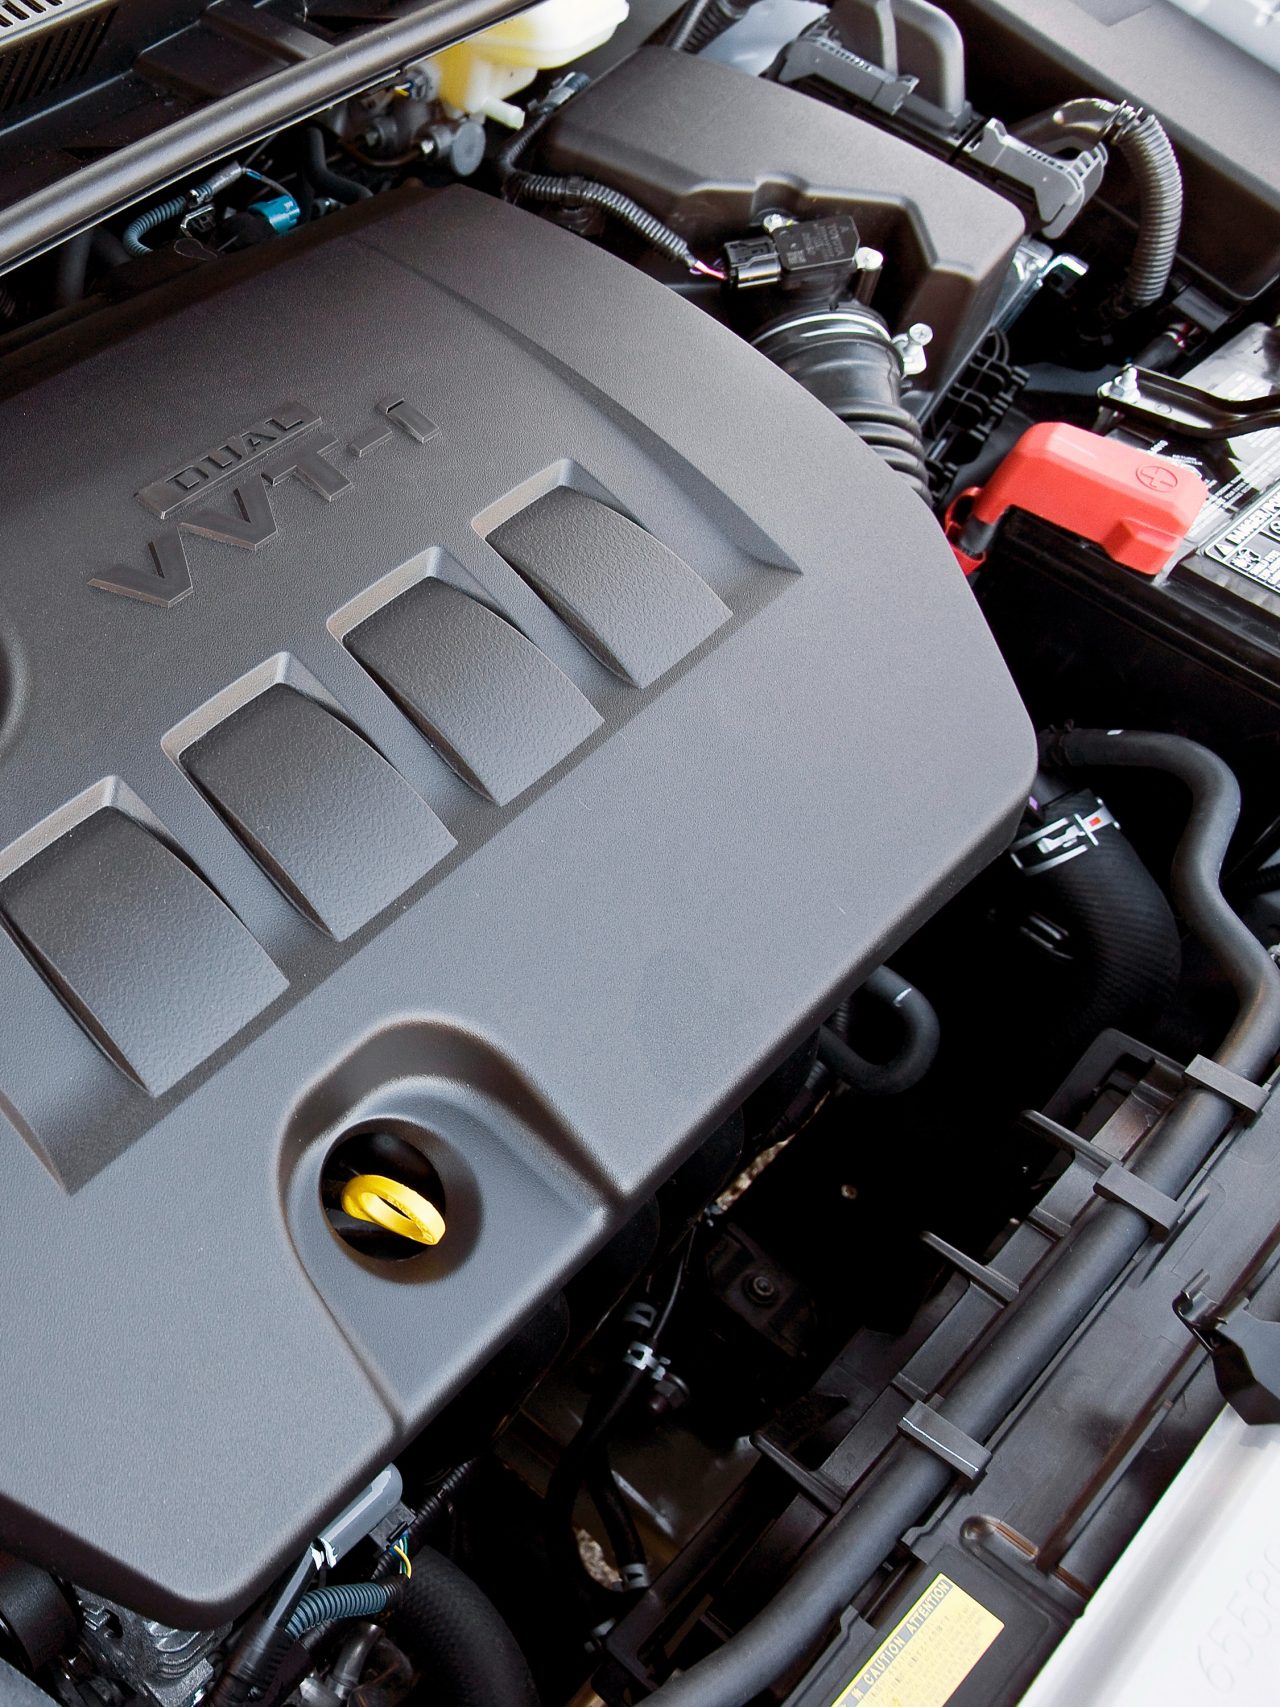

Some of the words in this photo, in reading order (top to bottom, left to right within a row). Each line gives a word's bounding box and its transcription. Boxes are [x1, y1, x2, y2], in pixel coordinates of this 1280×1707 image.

[165, 416, 304, 491] DUAL
[863, 1636, 906, 1685] CAUTION
[905, 1580, 952, 1634] ATTENTION
